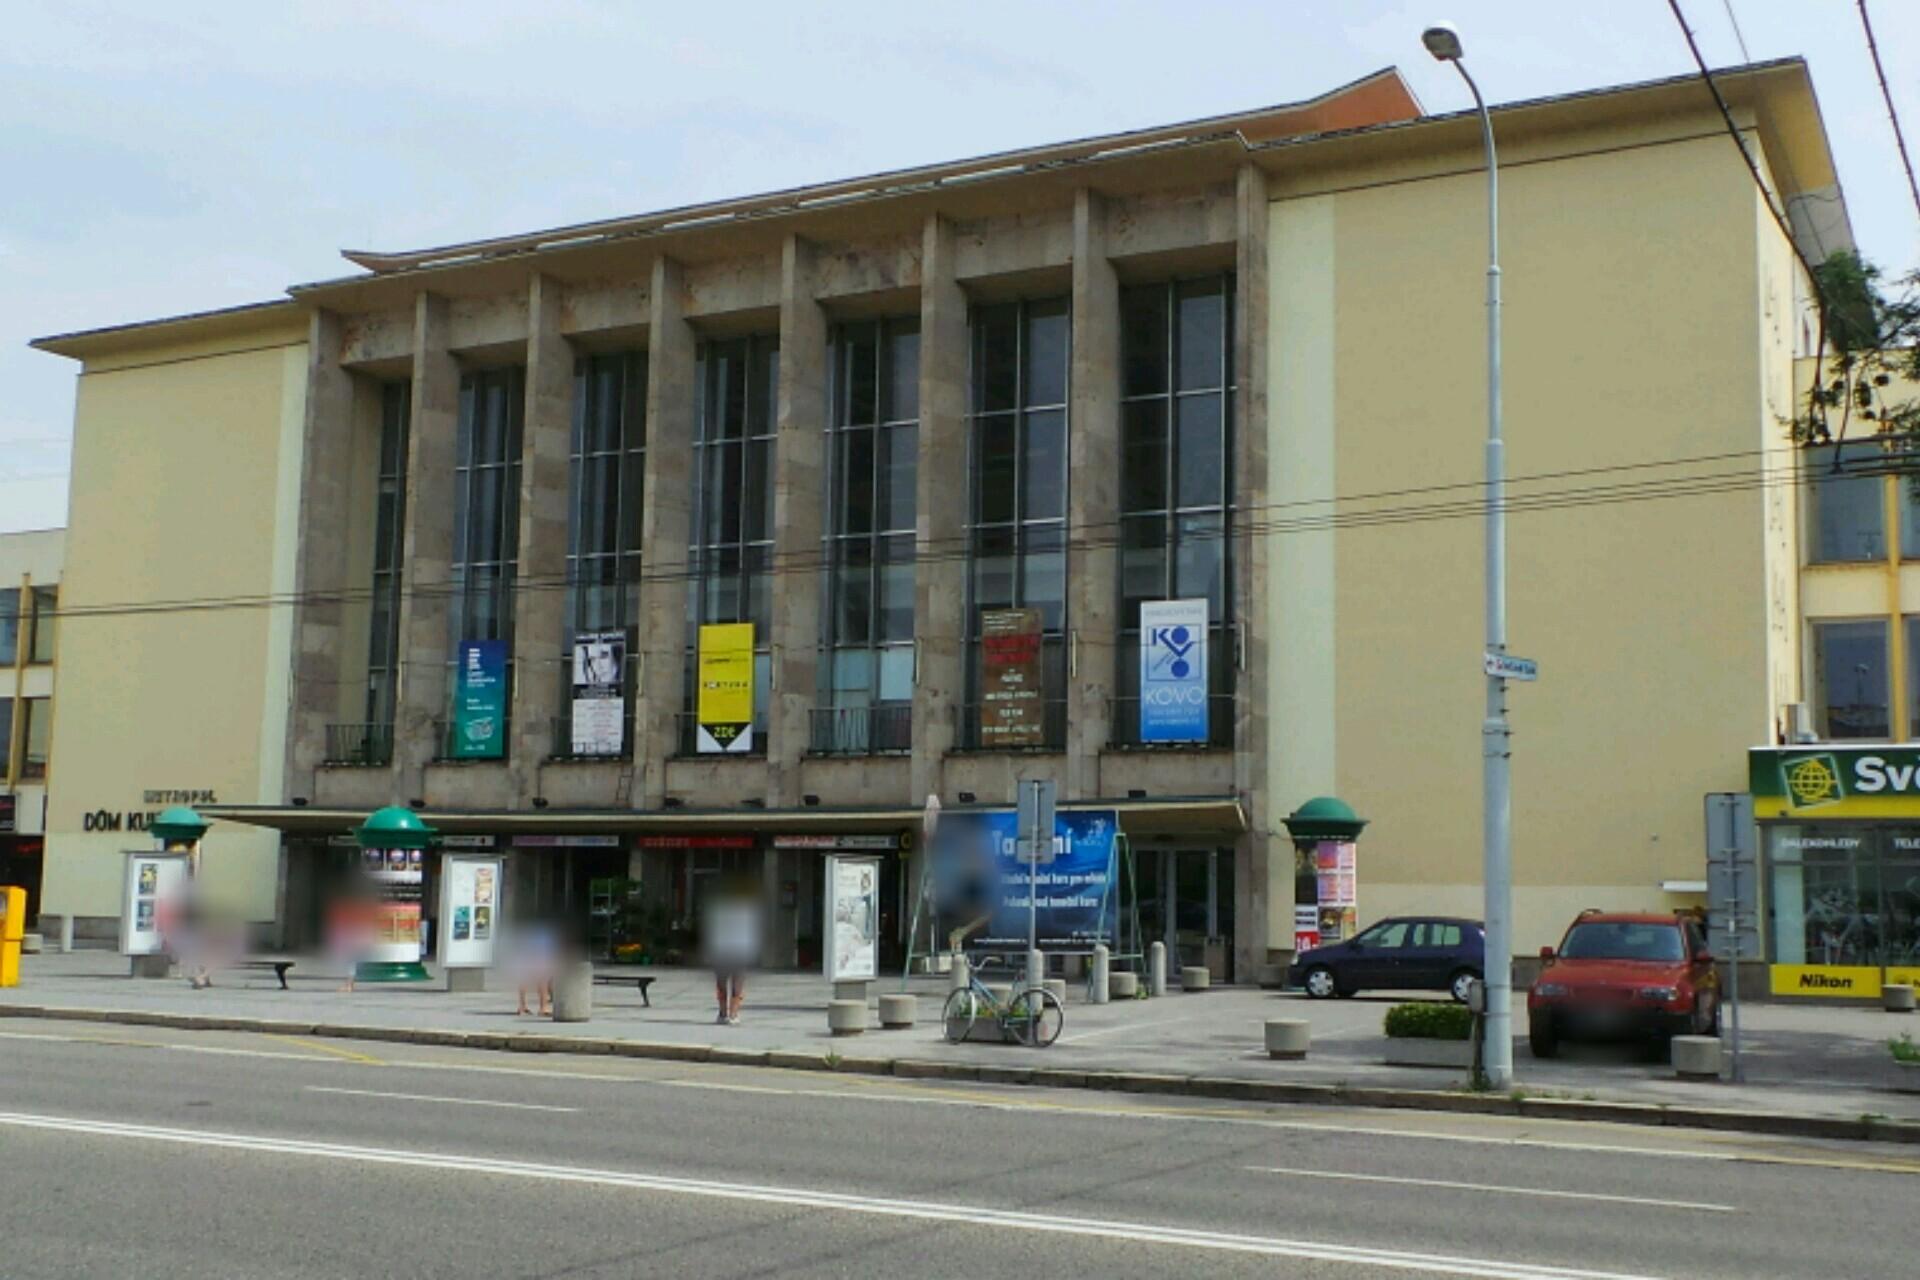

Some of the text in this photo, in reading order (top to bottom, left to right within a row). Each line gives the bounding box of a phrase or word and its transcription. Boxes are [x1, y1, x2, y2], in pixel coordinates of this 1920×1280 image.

[1145, 686, 1205, 706] KOVO
[1855, 755, 1920, 792] Sv
[1799, 973, 1854, 989] Nikon
